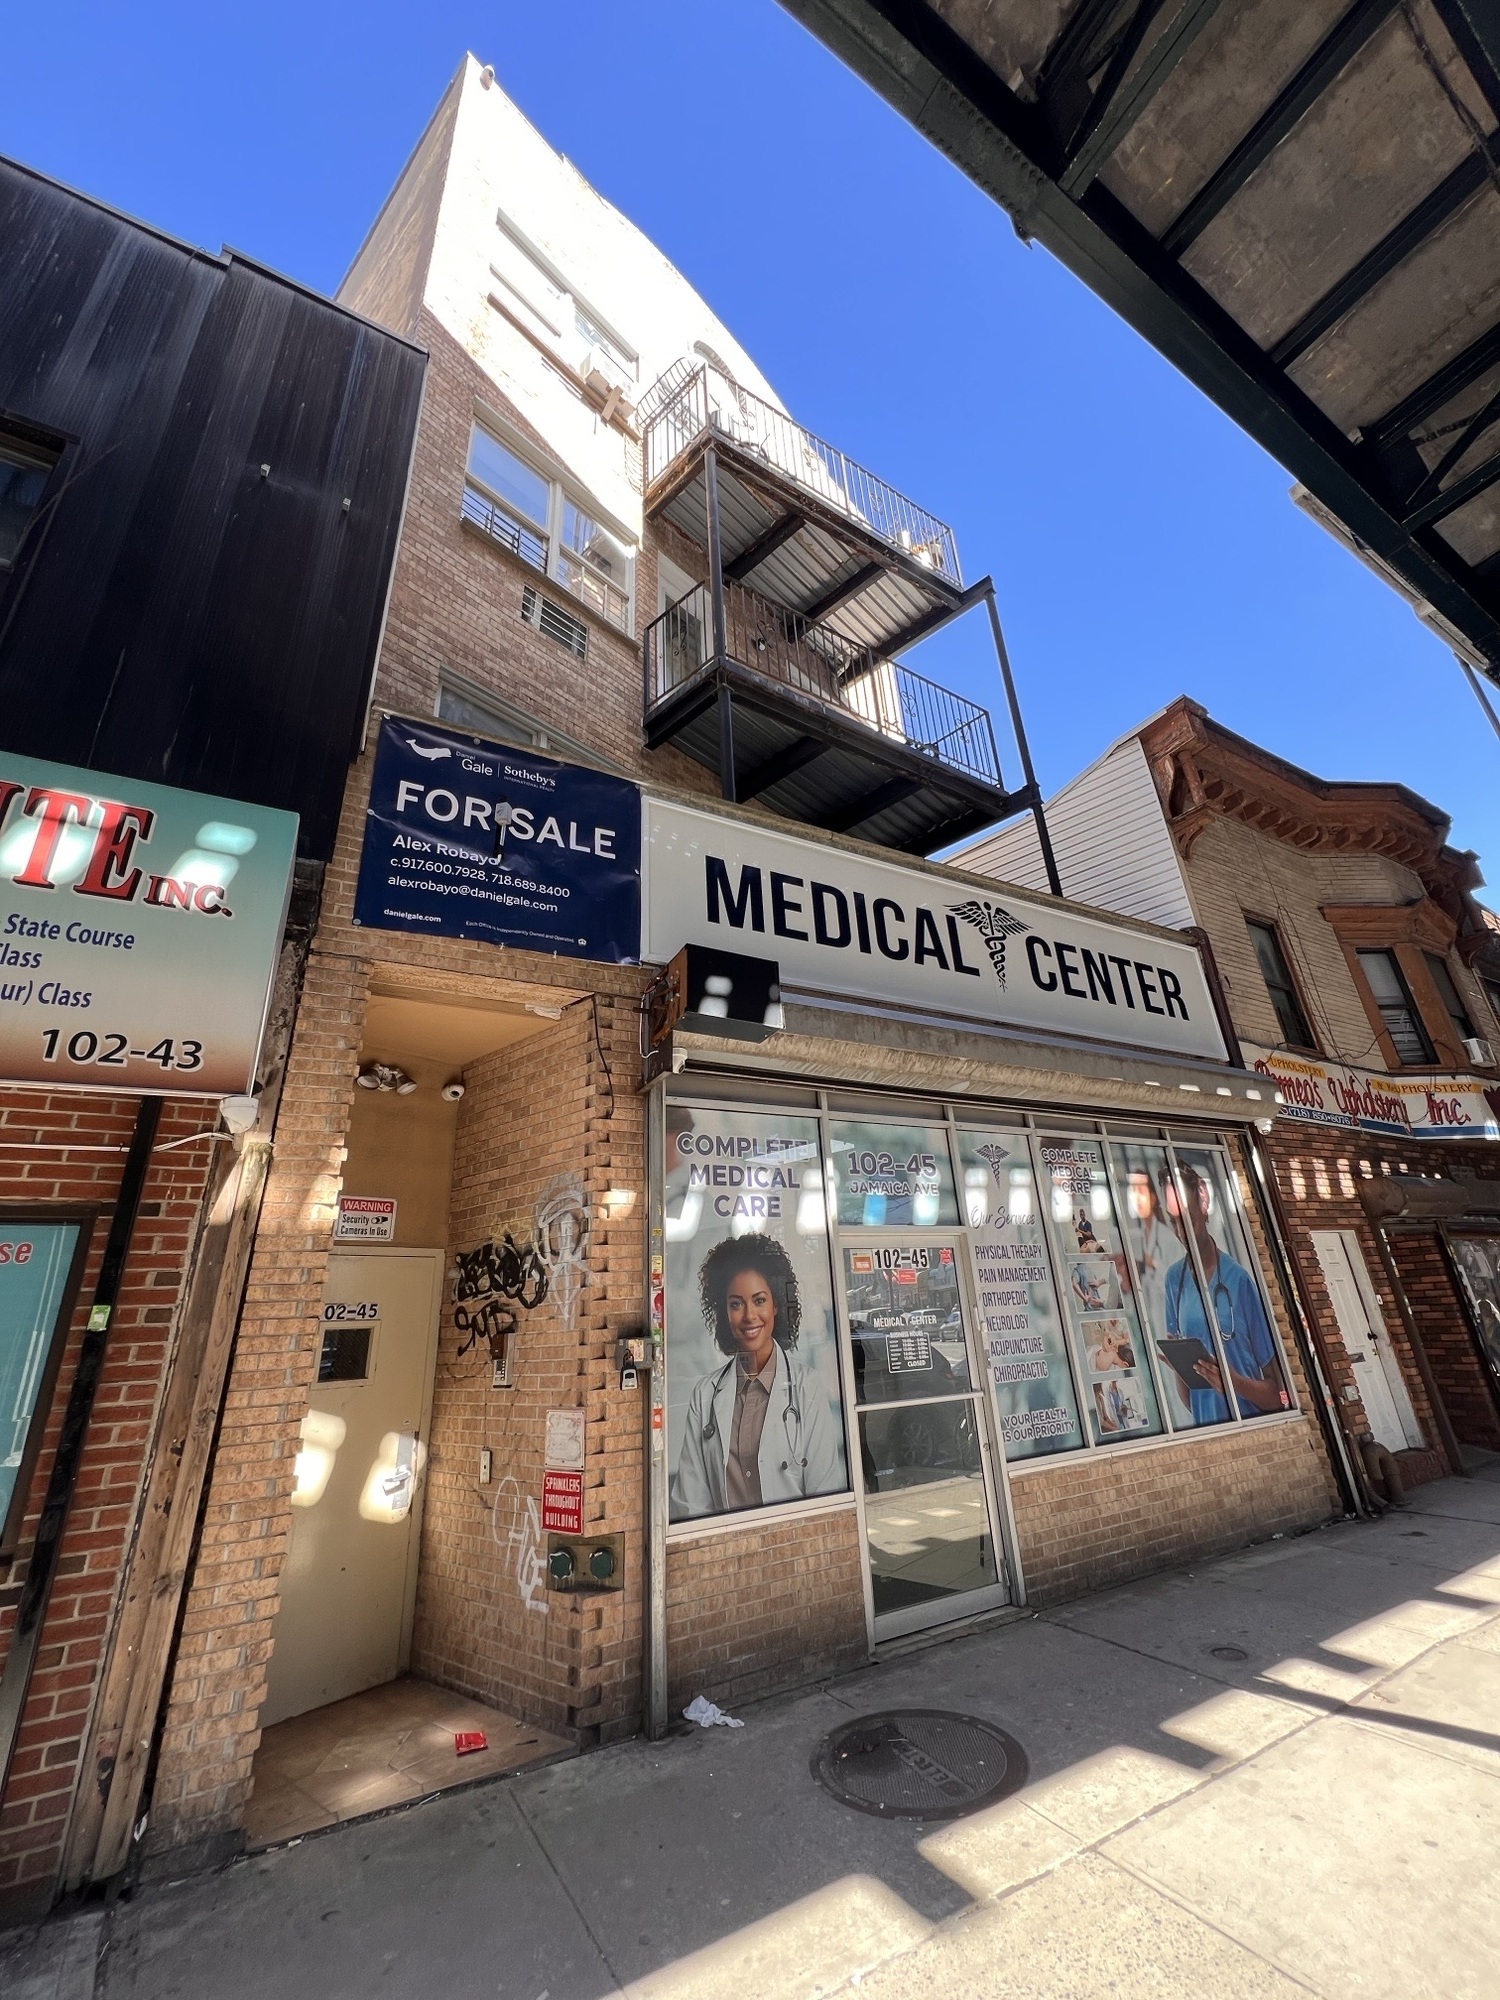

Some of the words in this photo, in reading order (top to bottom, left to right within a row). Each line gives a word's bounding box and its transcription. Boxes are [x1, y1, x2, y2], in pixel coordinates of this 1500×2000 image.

[461, 758, 493, 776] Gale
[504, 765, 557, 786] Sotheby's
[396, 780, 493, 831] FOR
[508, 807, 616, 860] SALE
[393, 834, 432, 853] Alex
[436, 843, 501, 866] Robayo
[387, 876, 558, 912] alexrobayo@danielgale.com
[491, 873, 570, 898] 718.689.8400
[143, 874, 233, 918] INC.
[384, 908, 442, 924] danielgale.com
[3, 913, 61, 940] State
[65, 921, 136, 950] Course
[705, 855, 981, 977] MEDICAL
[1024, 935, 1190, 1021] CENTER
[0, 942, 43, 969] lass
[37, 981, 92, 1009] Class
[41, 1028, 204, 1070] 102-43
[1271, 1058, 1323, 1077] UPHOLSTERY
[1254, 1059, 1324, 1110] meo's
[1327, 1074, 1415, 1137] Upholstery
[1425, 1089, 1472, 1126] Inc.
[1288, 1107, 1310, 1119] (718)
[677, 1132, 808, 1160] COMPLETE
[848, 1151, 937, 1178] 102-45
[1041, 1149, 1097, 1164] COMPLETE
[690, 1163, 800, 1188] MEDICAL
[1049, 1165, 1097, 1179] MEDICAL
[850, 1181, 912, 1195] JAMAICA
[914, 1182, 939, 1195] AVE
[1061, 1181, 1091, 1194] CARE
[343, 1200, 391, 1212] WARNING
[714, 1194, 782, 1218] CARE
[342, 1213, 370, 1226] Security
[971, 1205, 994, 1229] Our
[994, 1205, 1036, 1230] Services
[340, 1225, 368, 1236] Cameras
[376, 1227, 388, 1236] Use
[874, 1248, 928, 1269] 102-45
[974, 1244, 1010, 1260] PHYSICAL
[1010, 1244, 1042, 1259] THERAPY
[978, 1268, 997, 1283] PAIN
[997, 1266, 1047, 1283] MANAGEMENT
[982, 1290, 1029, 1308] ORTHOPEDIC
[873, 1316, 905, 1328] MEDICAL
[985, 1314, 1029, 1332] NEUROLOGY
[990, 1337, 1044, 1357] ACUPUNCTURE
[907, 1359, 927, 1368] CLOSED
[993, 1361, 1048, 1383] CHIROPRACTIC
[1004, 1413, 1032, 1428] YOUR
[1033, 1408, 1067, 1423] HEALTH
[1002, 1431, 1012, 1442] IS
[1013, 1427, 1036, 1441] OUR
[1036, 1421, 1075, 1438] PRIORITY
[545, 1477, 581, 1493] SPRINKLERS
[545, 1493, 580, 1511] THROUGHOUT
[545, 1512, 579, 1529] BUILDING
